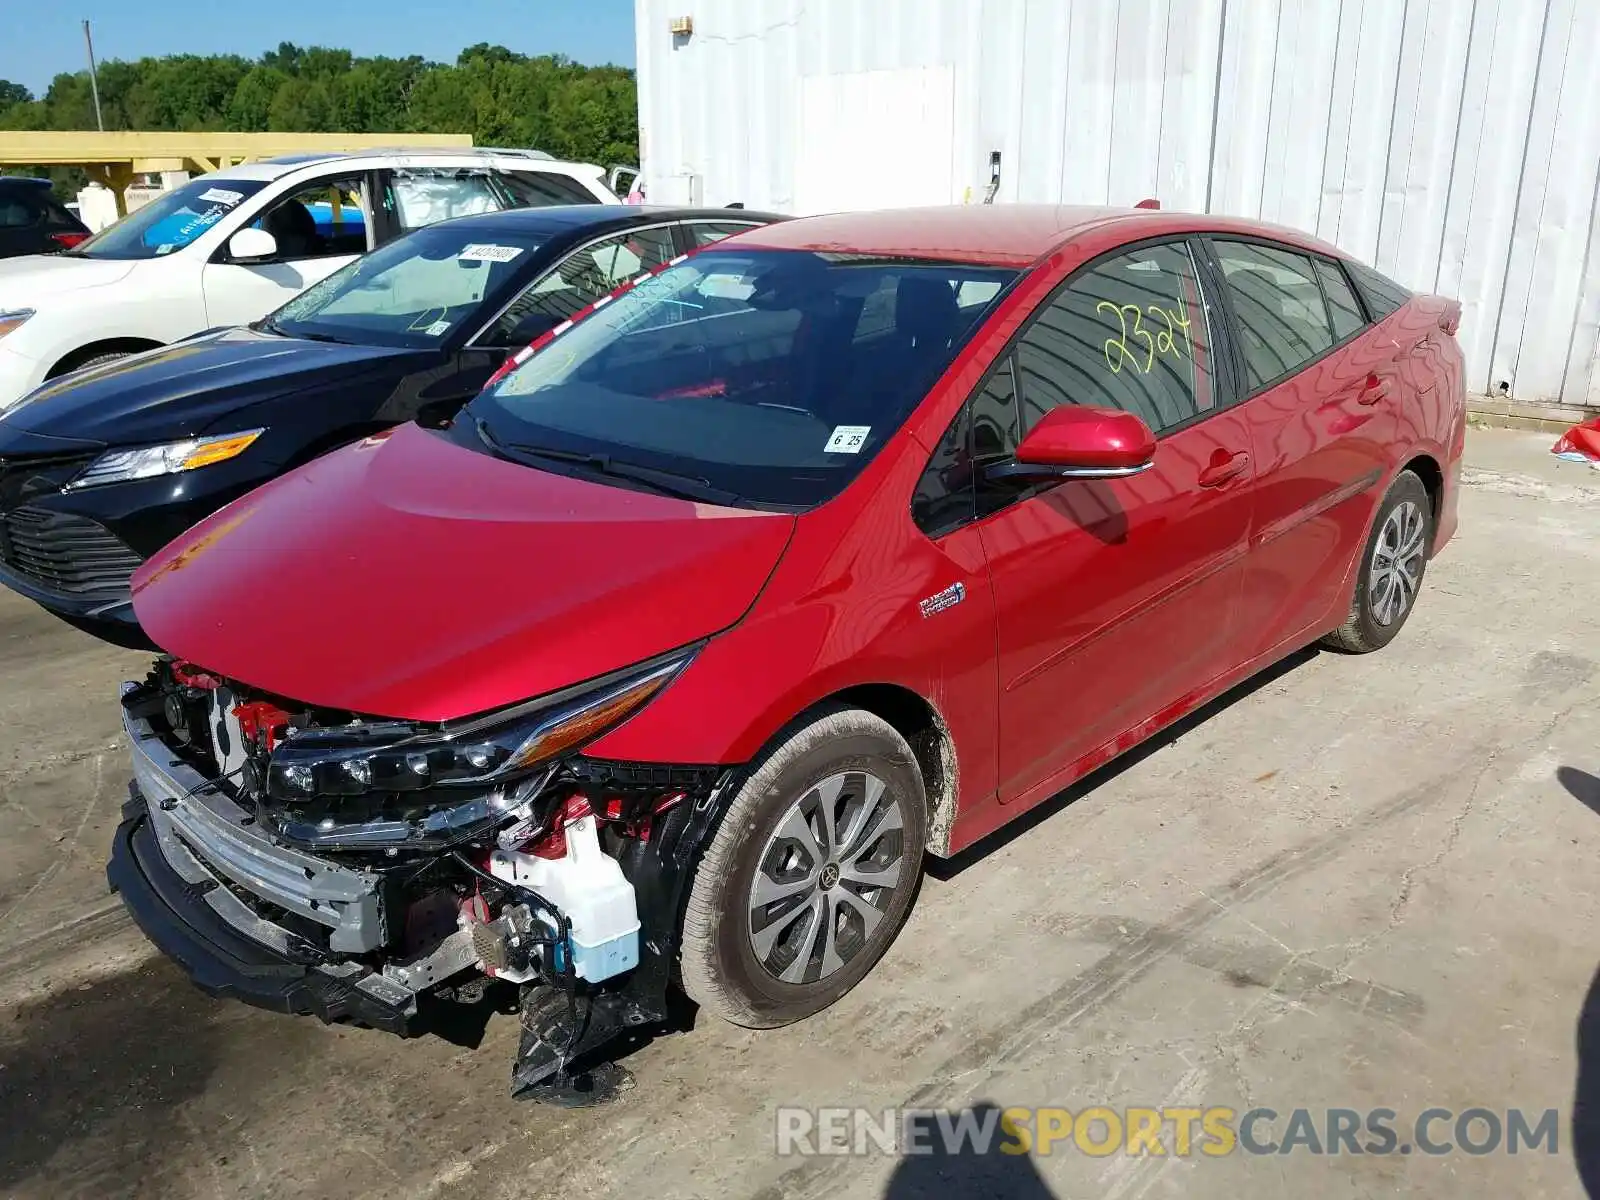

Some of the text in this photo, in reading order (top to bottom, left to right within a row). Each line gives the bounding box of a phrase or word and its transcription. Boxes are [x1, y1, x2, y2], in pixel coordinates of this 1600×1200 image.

[1096, 296, 1192, 375] 2324
[834, 434, 863, 446] 6 25
